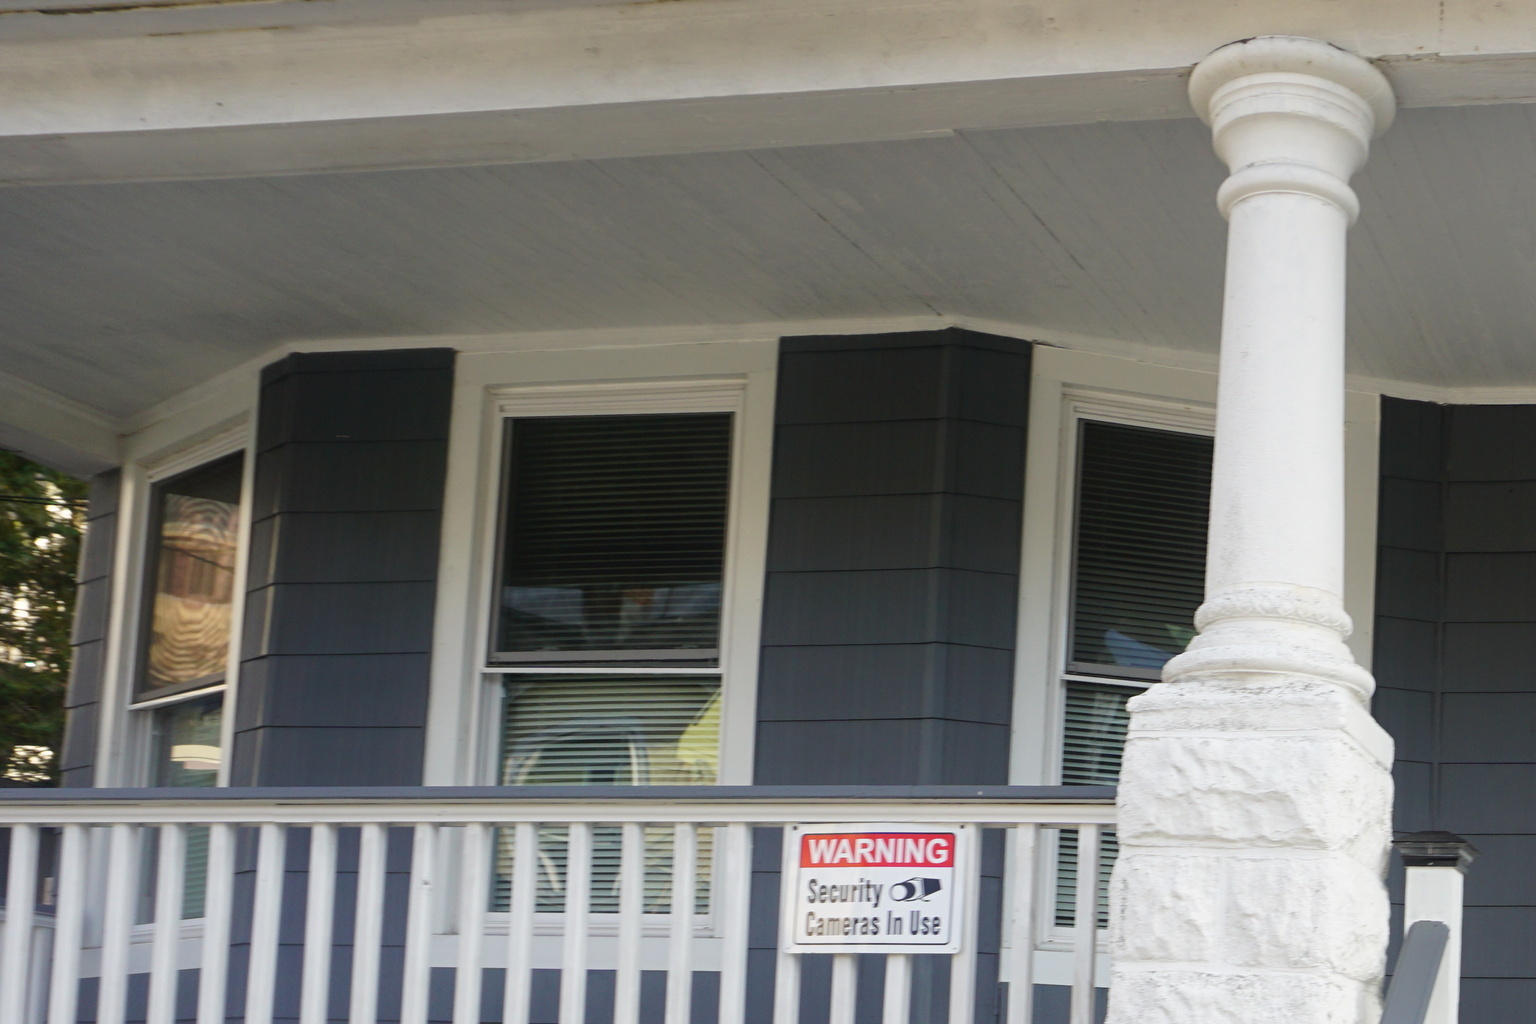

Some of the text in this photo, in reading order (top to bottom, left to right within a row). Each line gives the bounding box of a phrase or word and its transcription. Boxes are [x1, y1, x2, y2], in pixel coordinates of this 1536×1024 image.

[807, 837, 949, 865] WARNING
[807, 877, 884, 908] Security
[806, 909, 942, 937] Cameras In Use
